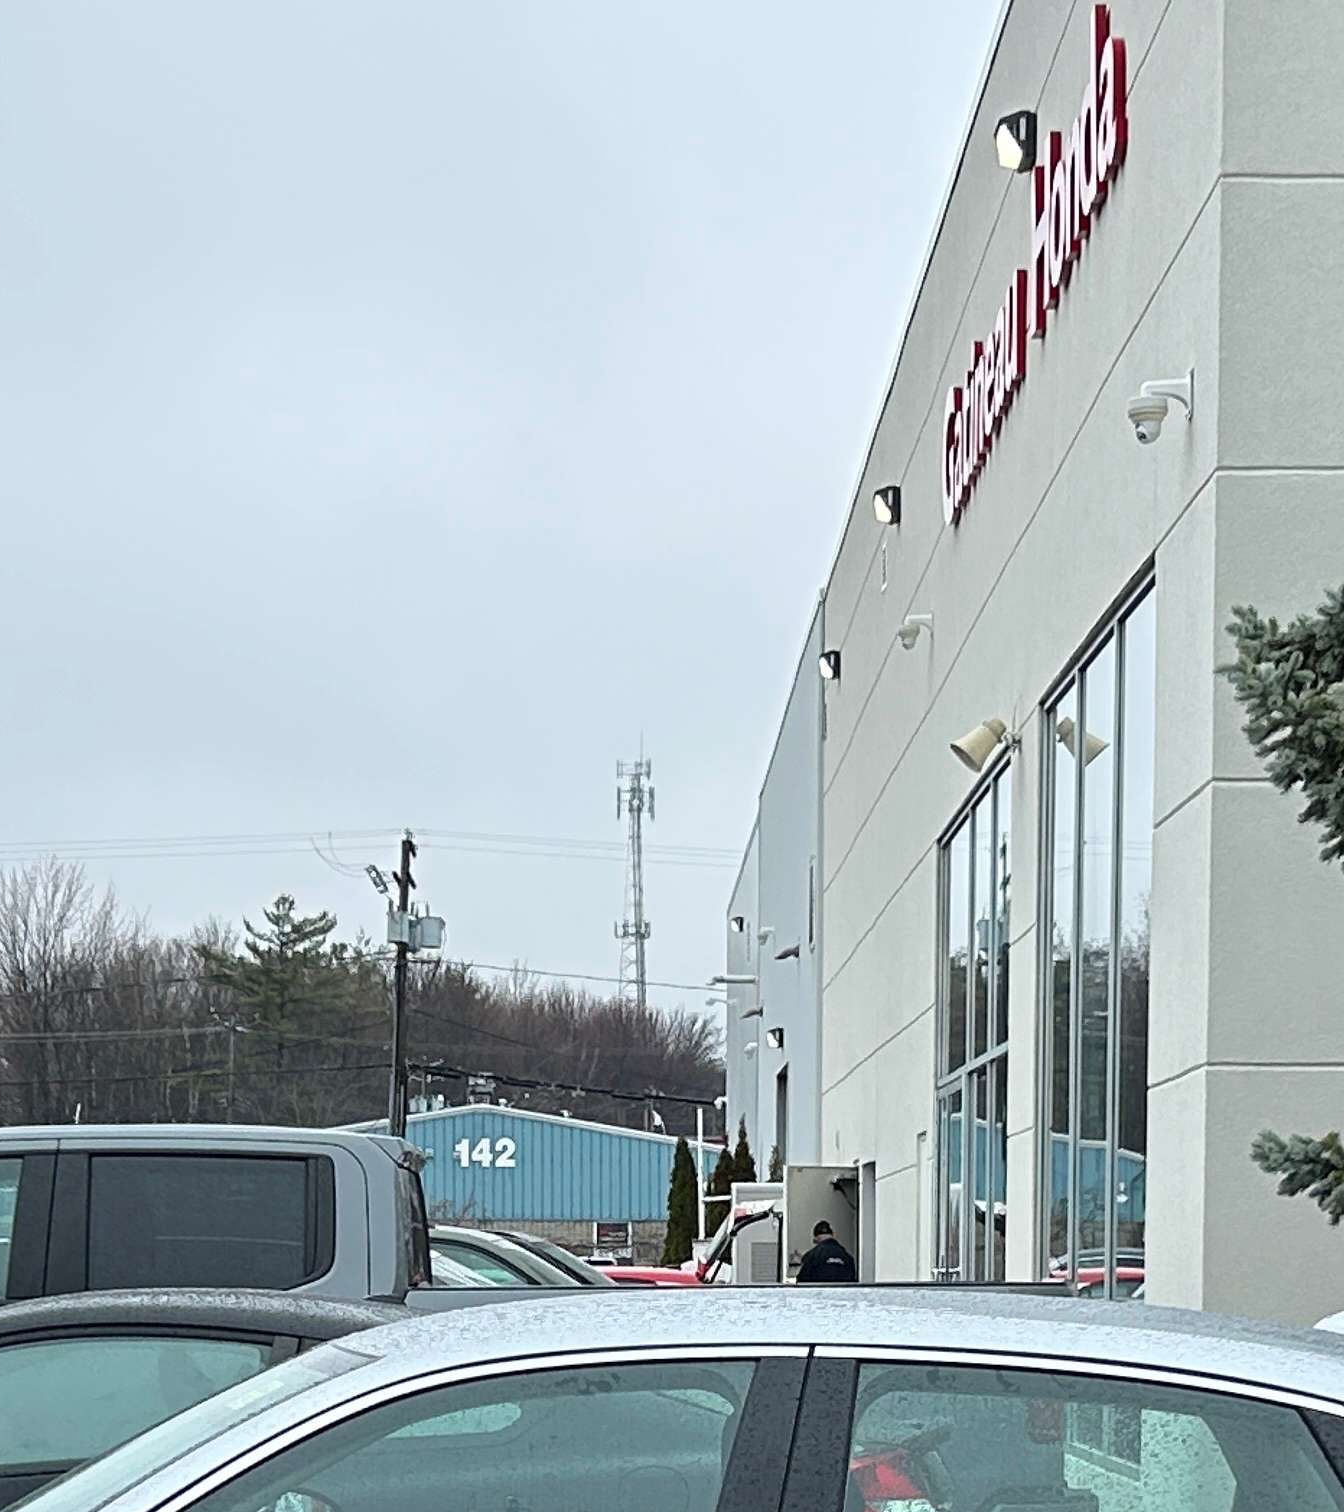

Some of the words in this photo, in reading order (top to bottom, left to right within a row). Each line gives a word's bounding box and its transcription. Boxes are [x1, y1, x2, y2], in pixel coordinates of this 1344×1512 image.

[941, 268, 1028, 527] Gatineau
[1029, 3, 1128, 339] Honda
[454, 1137, 516, 1168] 142
